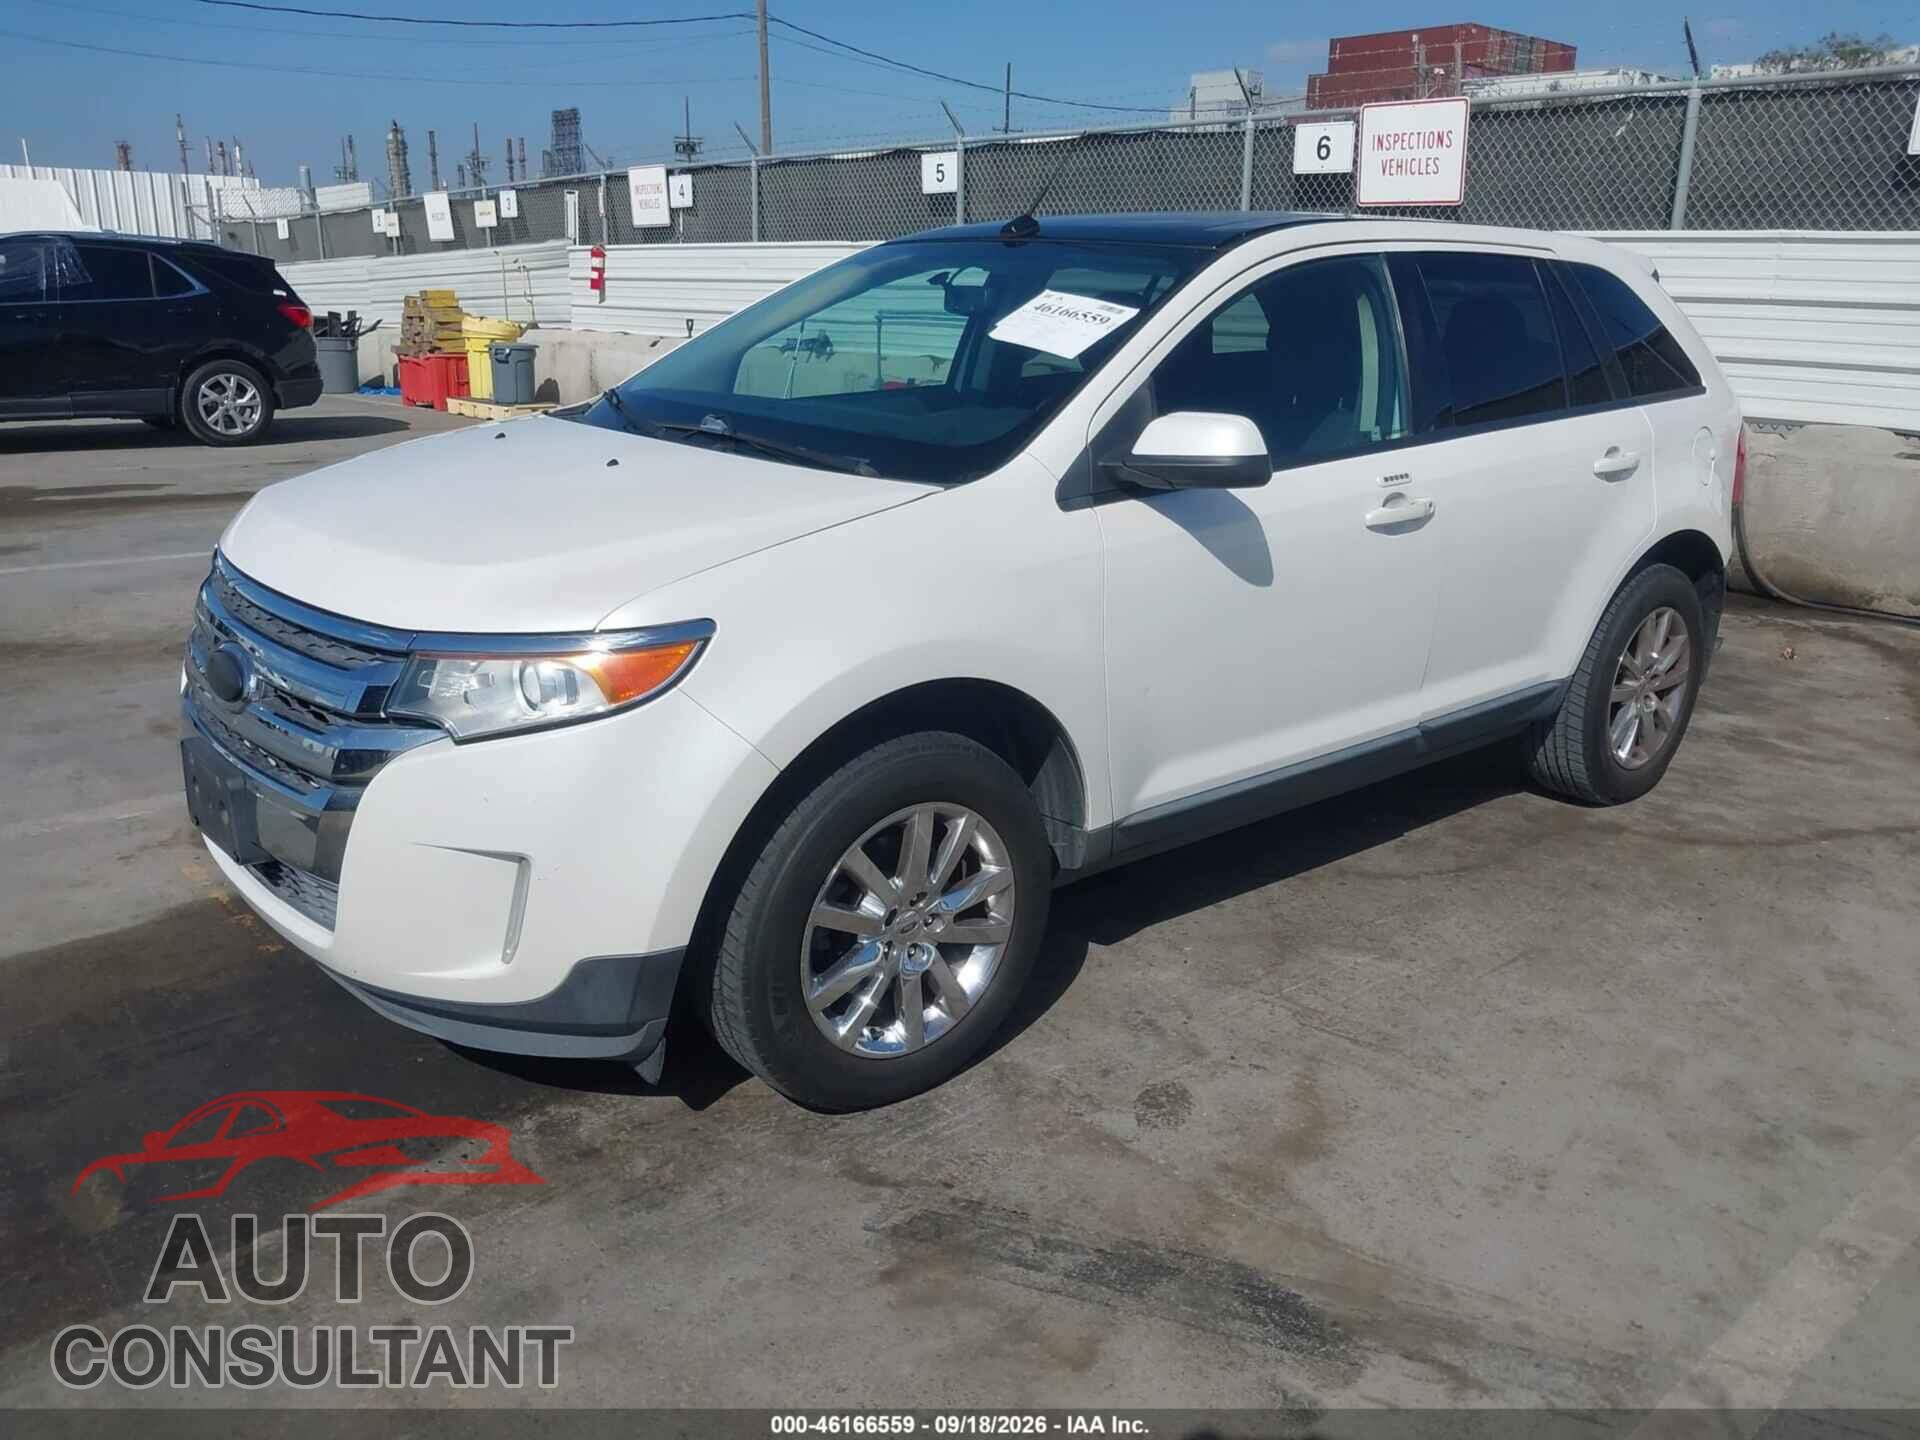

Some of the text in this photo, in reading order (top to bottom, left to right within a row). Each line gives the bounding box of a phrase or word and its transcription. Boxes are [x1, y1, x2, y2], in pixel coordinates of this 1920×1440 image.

[1316, 135, 1332, 161] 6
[1372, 129, 1454, 152] INSPECTIONS
[936, 163, 945, 183] 5
[1381, 156, 1440, 177] VEHICLES
[679, 183, 686, 199] 4
[1034, 302, 1112, 325] 46166559
